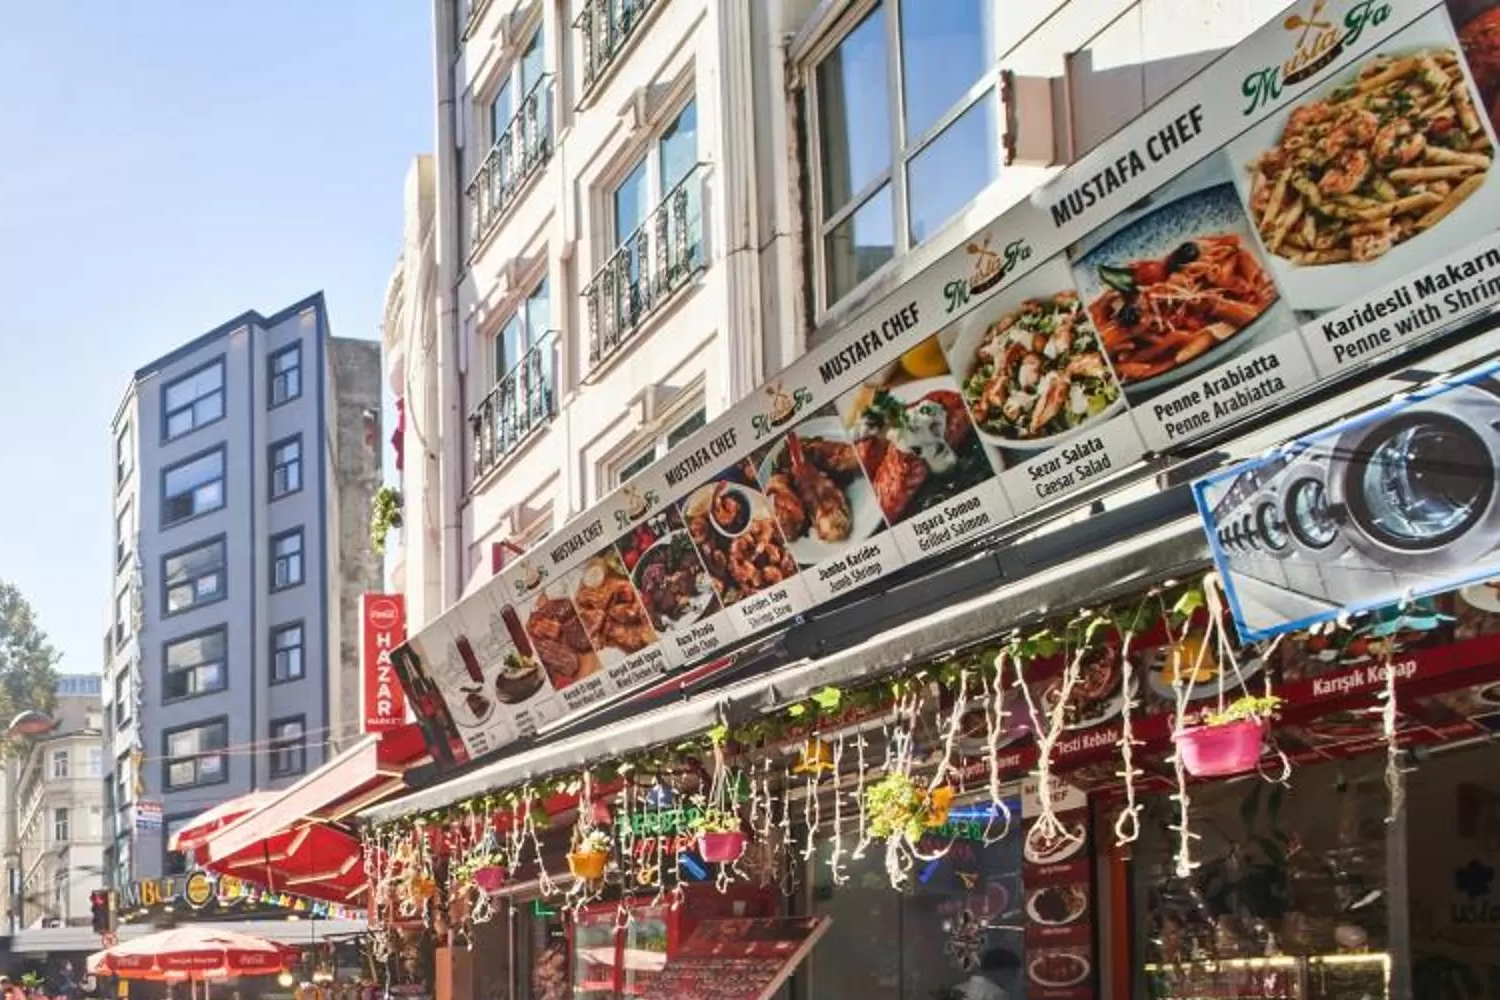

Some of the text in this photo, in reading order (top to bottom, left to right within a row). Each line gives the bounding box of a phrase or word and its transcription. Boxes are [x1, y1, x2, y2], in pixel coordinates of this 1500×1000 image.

[1051, 103, 1204, 228] MUSTAFA CHEF
[1322, 248, 1500, 342] Karidesli Makarn
[818, 302, 921, 384] MUSTAFA CHEF
[1333, 327, 1391, 363] Penne
[1394, 303, 1442, 336] with
[1153, 354, 1280, 421] Penne Arabiatta
[1165, 376, 1285, 439] Penne Arabiatta
[665, 427, 739, 486] MUSTAFA CHEF
[1028, 437, 1104, 481] Sezar Salata
[1035, 453, 1111, 499] Caesar Salad
[550, 519, 605, 565] MUSTAFA CHEF
[376, 632, 392, 716] HAZAR
[1312, 659, 1417, 697] Karışık Keap
